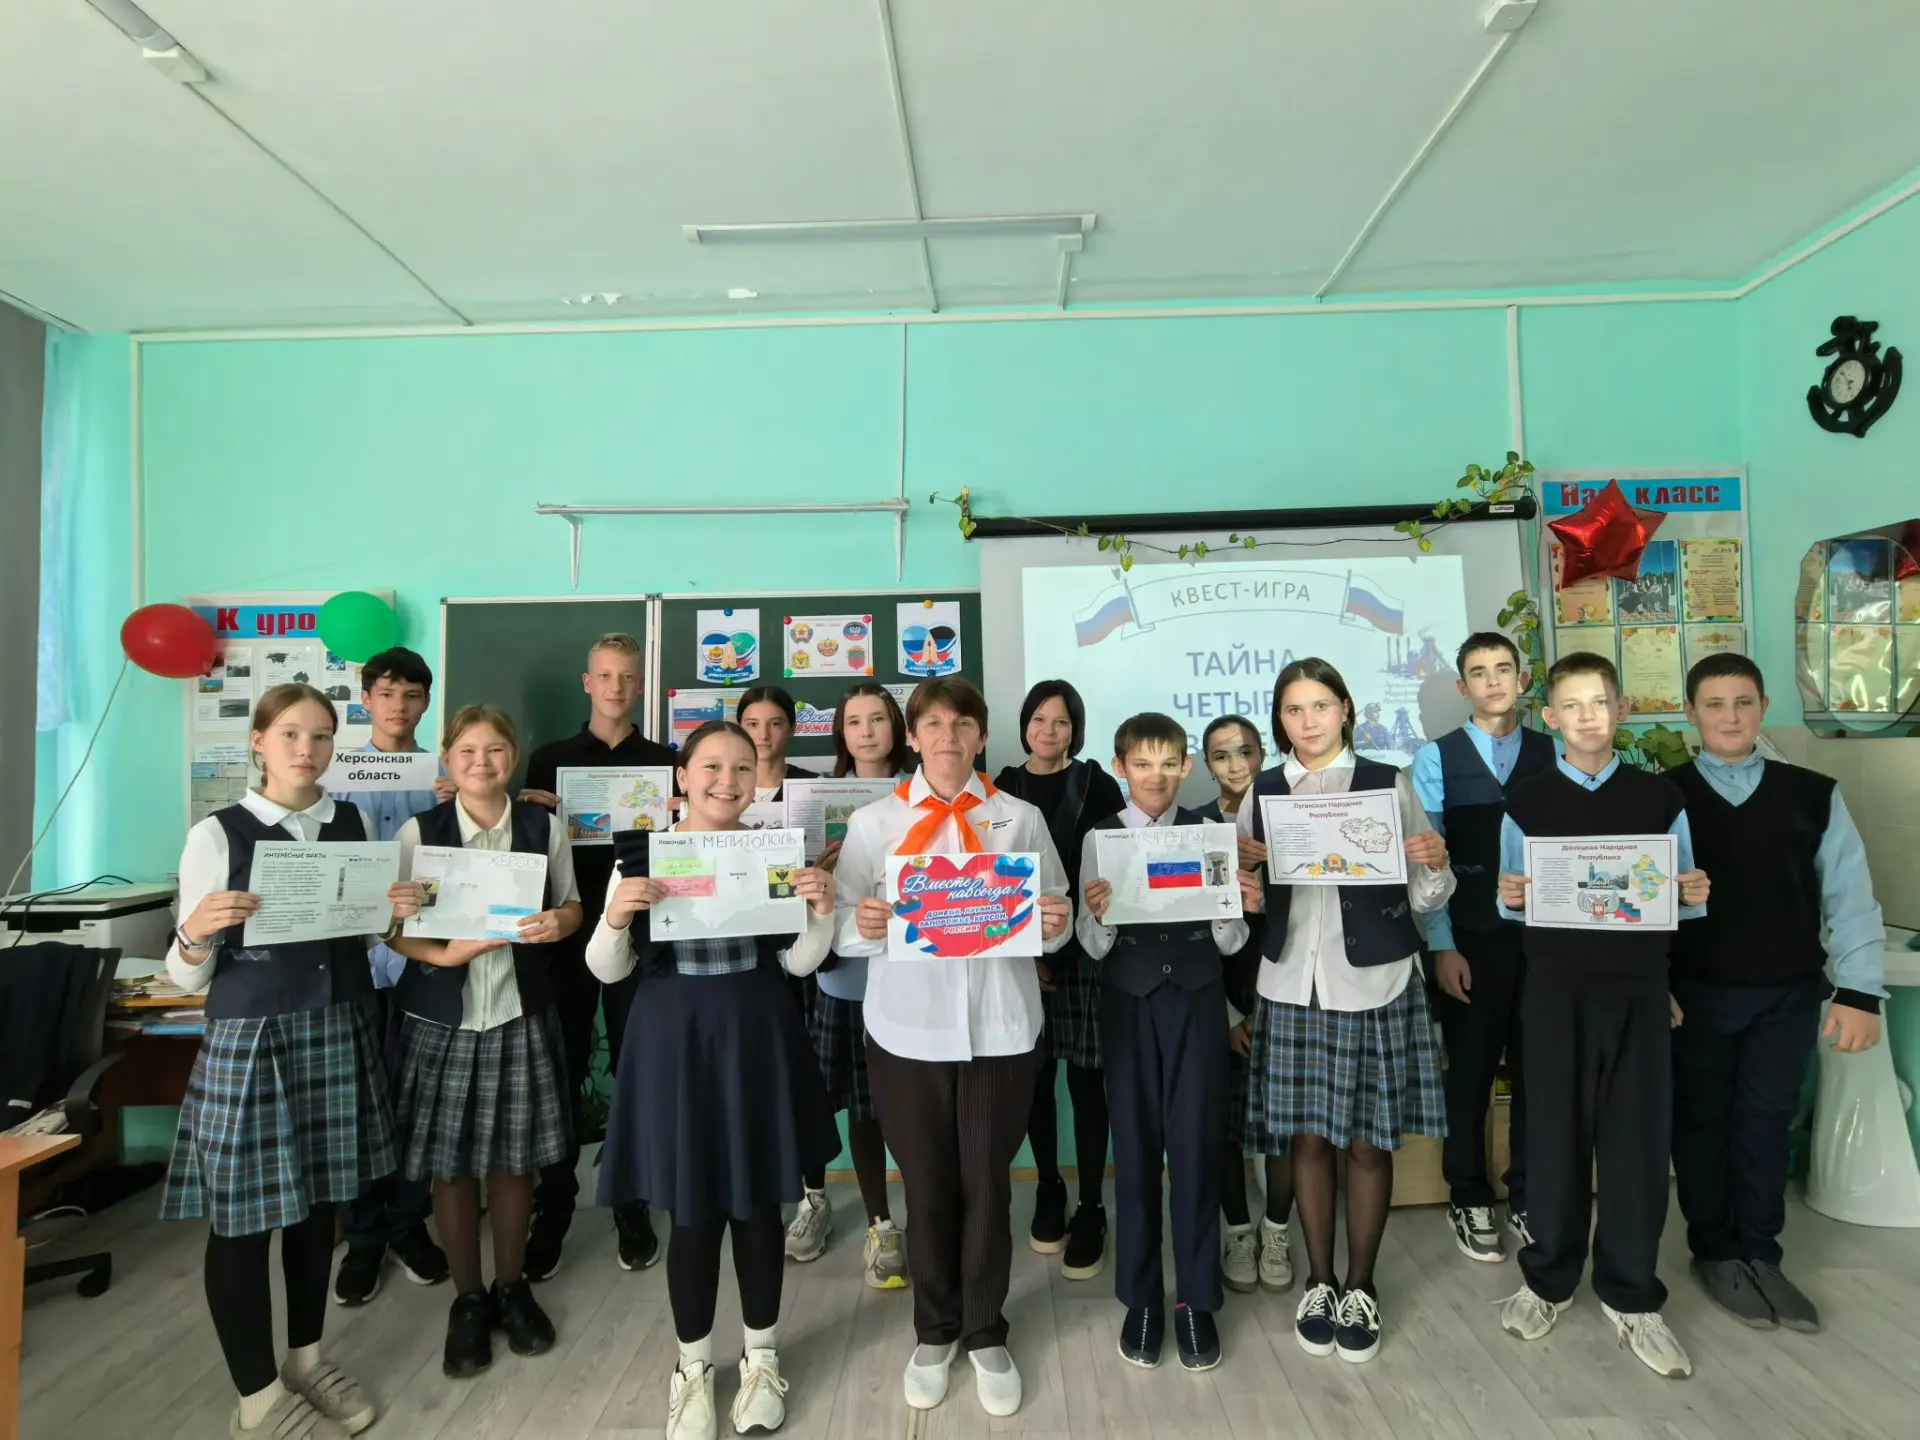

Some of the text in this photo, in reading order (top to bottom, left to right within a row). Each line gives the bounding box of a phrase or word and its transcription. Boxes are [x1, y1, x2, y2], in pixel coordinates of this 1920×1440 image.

[1561, 482, 1720, 506] На класс
[1171, 581, 1311, 607] КВЕСТ-ИГРА
[217, 608, 316, 636] К уро
[1186, 643, 1295, 677] ТАЙНА
[1173, 690, 1275, 718] ЧЕТЫР
[794, 724, 833, 733] РУЖБ
[335, 752, 413, 765] Херсонская
[348, 770, 401, 781] область
[1328, 800, 1363, 808] Народная
[1309, 811, 1348, 819] Республика
[687, 837, 693, 845] 3
[703, 832, 797, 848] МЕЛИТОПОЛЬ
[488, 855, 545, 869] ХЕРСОН
[902, 873, 972, 894] Вместе
[947, 879, 1026, 902] навсегда!
